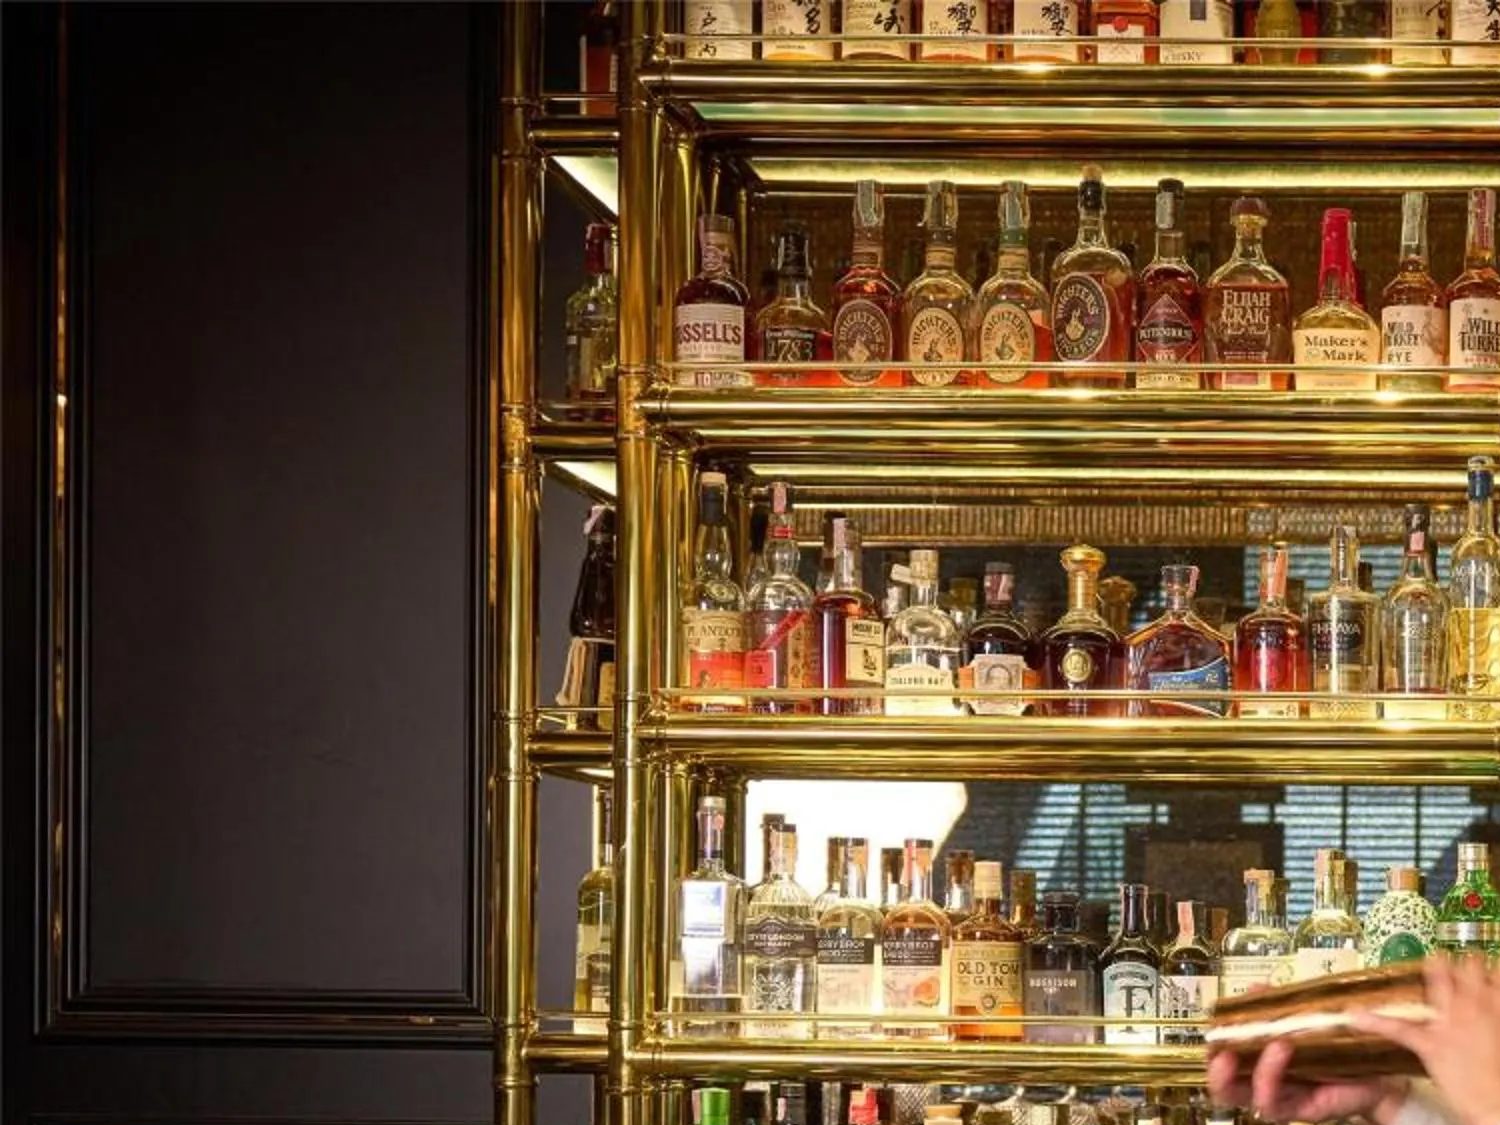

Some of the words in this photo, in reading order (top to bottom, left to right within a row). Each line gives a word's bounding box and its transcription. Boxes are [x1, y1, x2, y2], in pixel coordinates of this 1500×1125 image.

[1222, 290, 1272, 307] ELIJAH
[1221, 307, 1270, 328] CRAIG
[676, 322, 742, 345] SSELL'S
[1304, 335, 1369, 348] Maker's
[1321, 349, 1368, 362] Mark
[1387, 351, 1413, 363] RYE
[972, 975, 1004, 987] GIN
